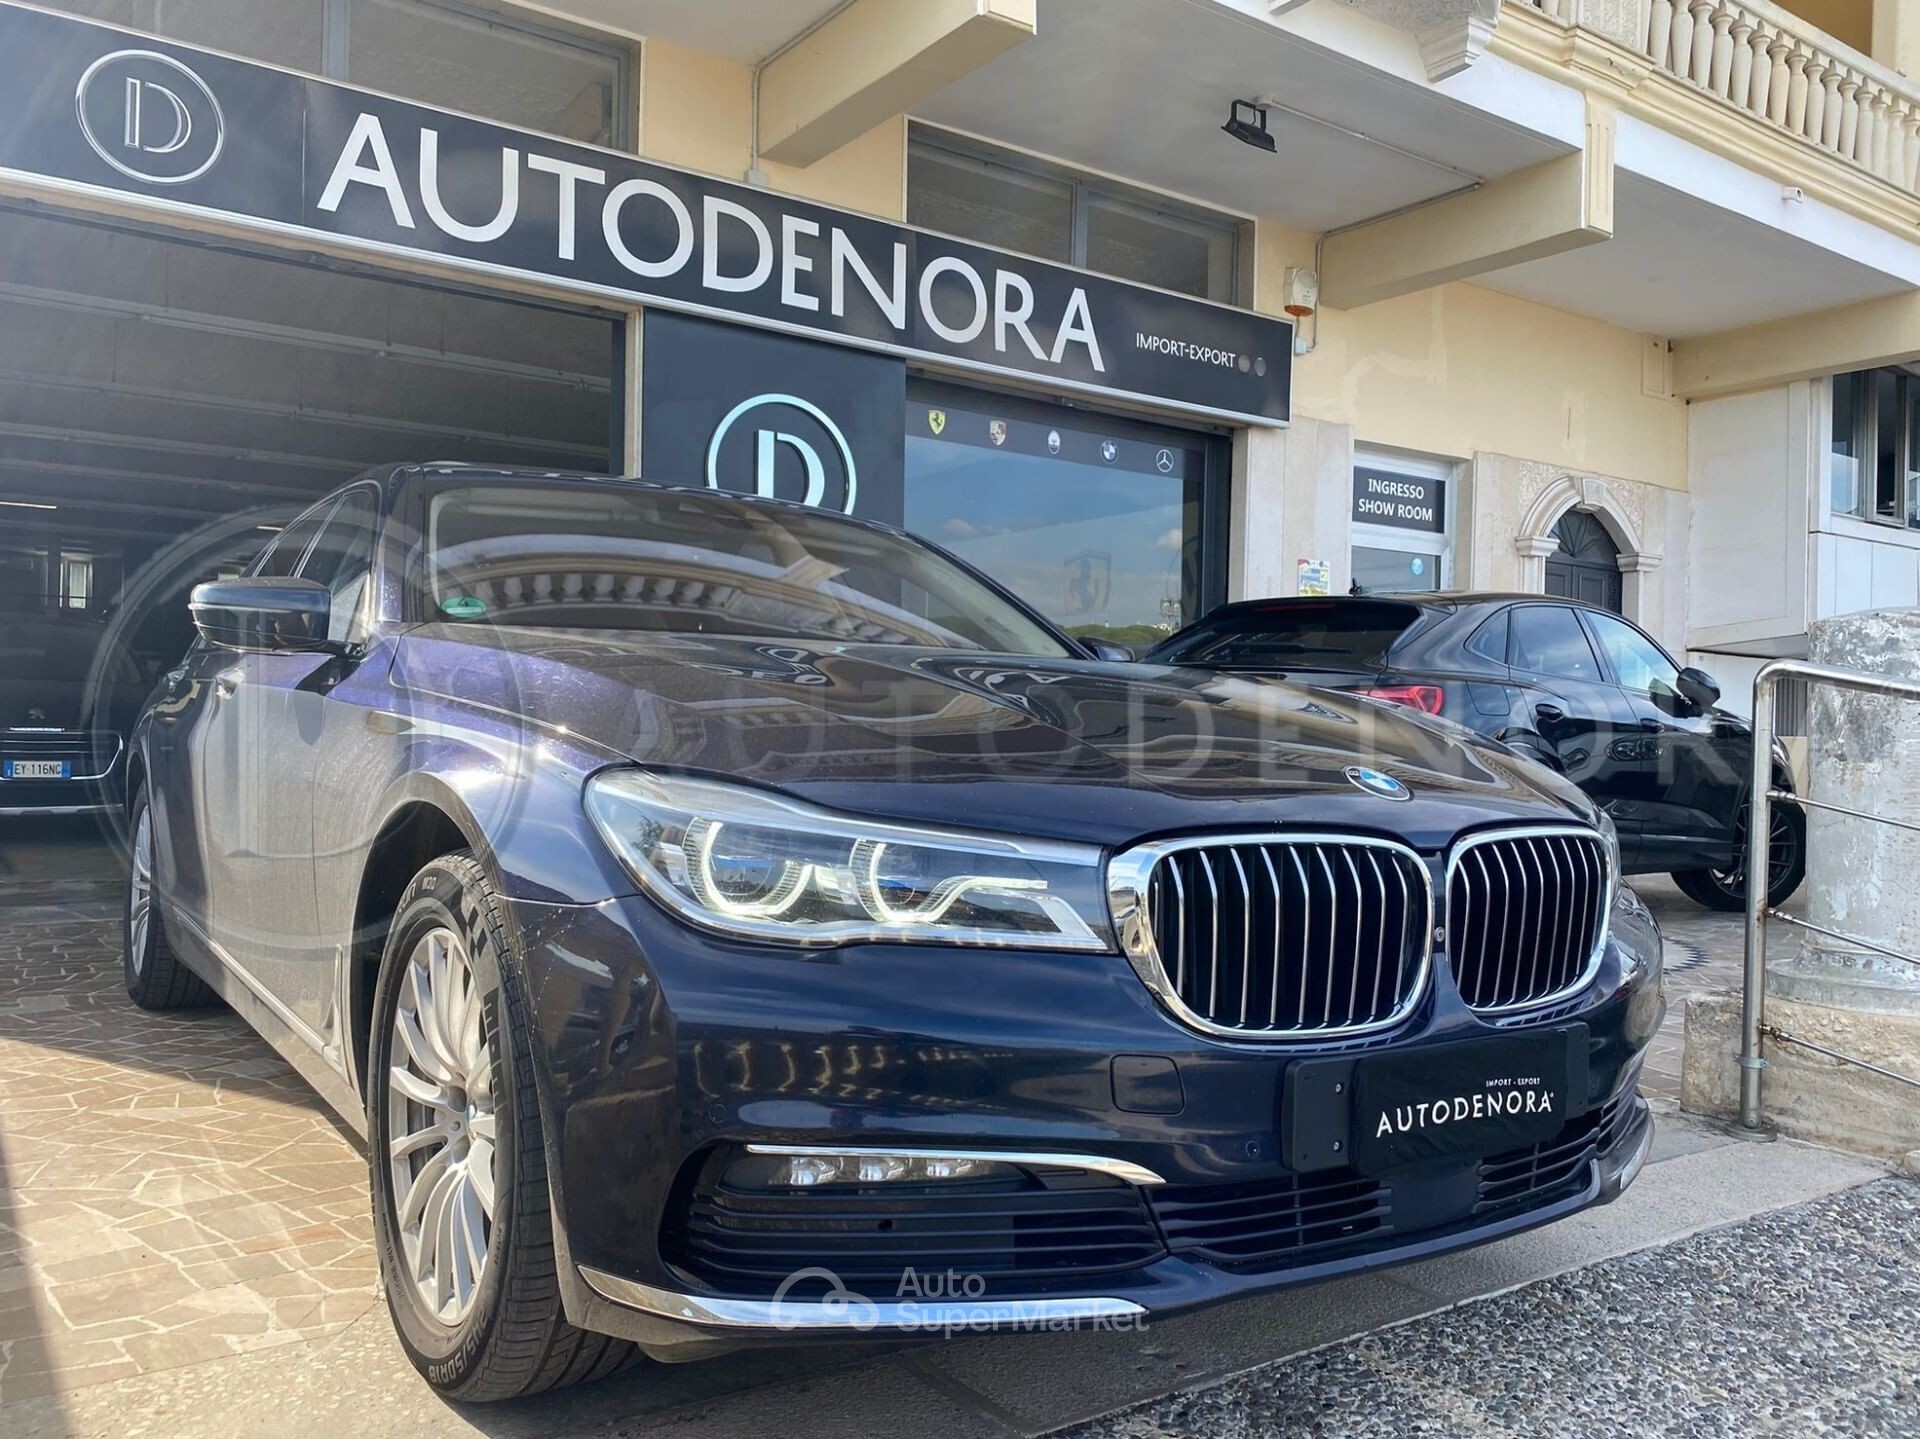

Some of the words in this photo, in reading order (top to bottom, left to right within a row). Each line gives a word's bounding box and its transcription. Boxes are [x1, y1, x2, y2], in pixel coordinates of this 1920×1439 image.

[317, 112, 1106, 373] AUTODENORA
[1136, 332, 1236, 368] IMPORT-EXPORT
[1367, 478, 1425, 500] INGRESSO
[1358, 498, 1395, 516] SHOW
[1397, 503, 1433, 521] ROOM
